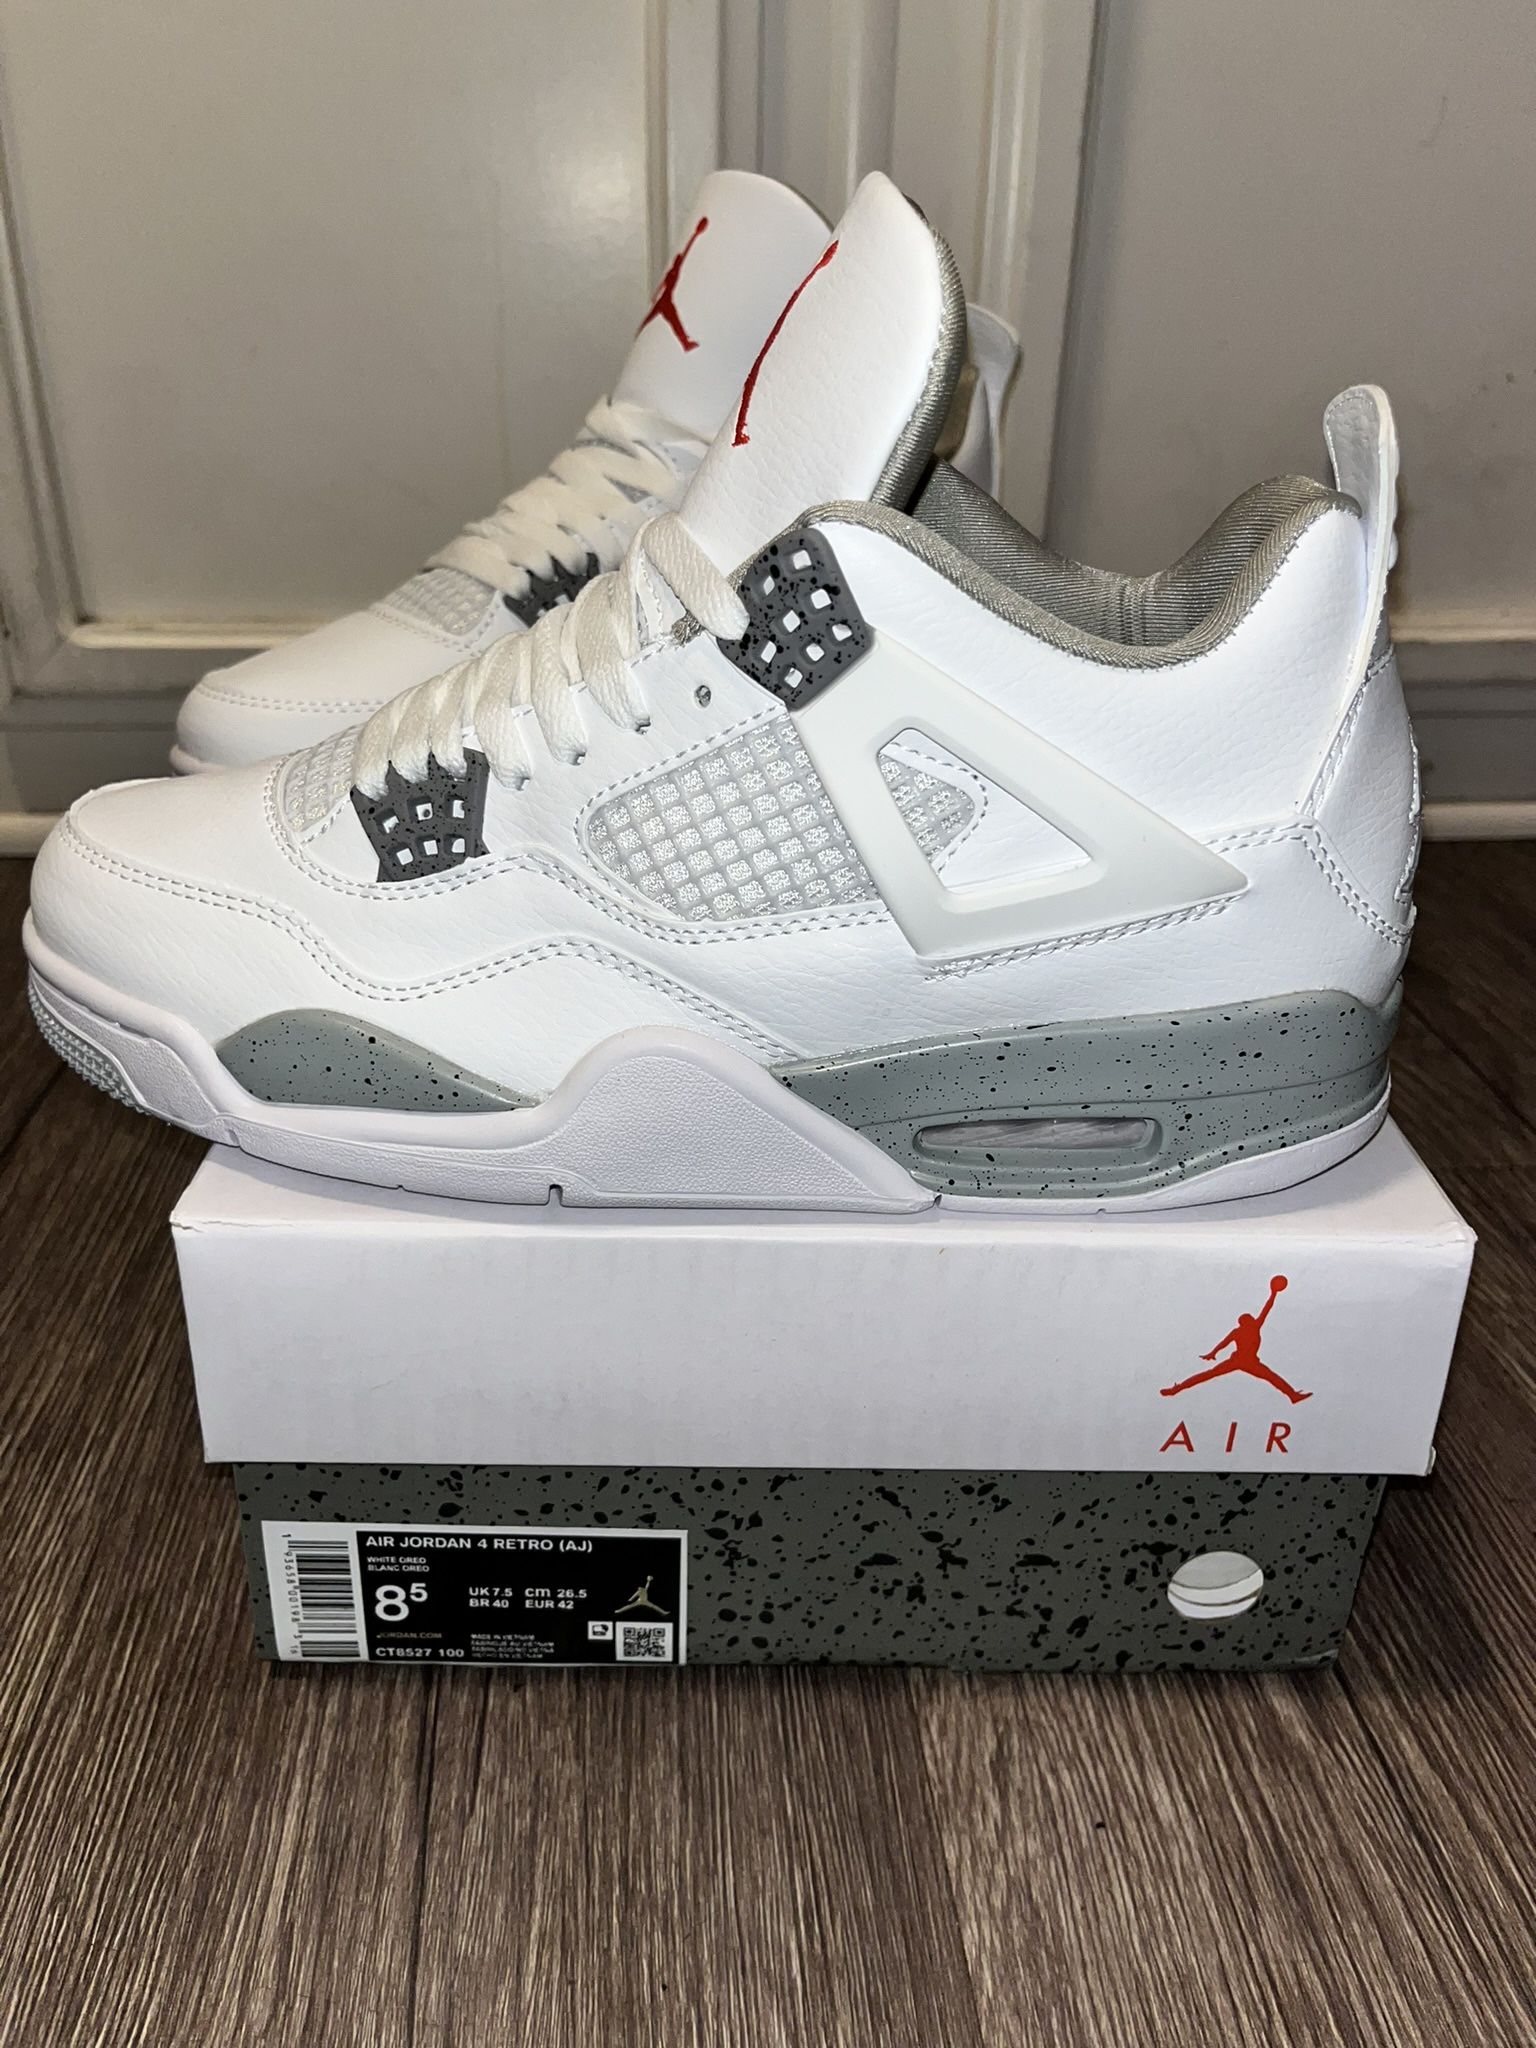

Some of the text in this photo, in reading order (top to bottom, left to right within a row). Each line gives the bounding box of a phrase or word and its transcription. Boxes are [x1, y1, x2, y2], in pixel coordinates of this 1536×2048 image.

[1159, 1420, 1292, 1453] AIR
[365, 1536, 593, 1553] AIR JORDAN 4 RETRO (AJ)
[468, 1586, 587, 1598] UK 7.5 cm 26.5
[468, 1598, 574, 1609] BR 40 EUR 42
[375, 1647, 433, 1657] CT8527
[438, 1648, 465, 1658] 100
